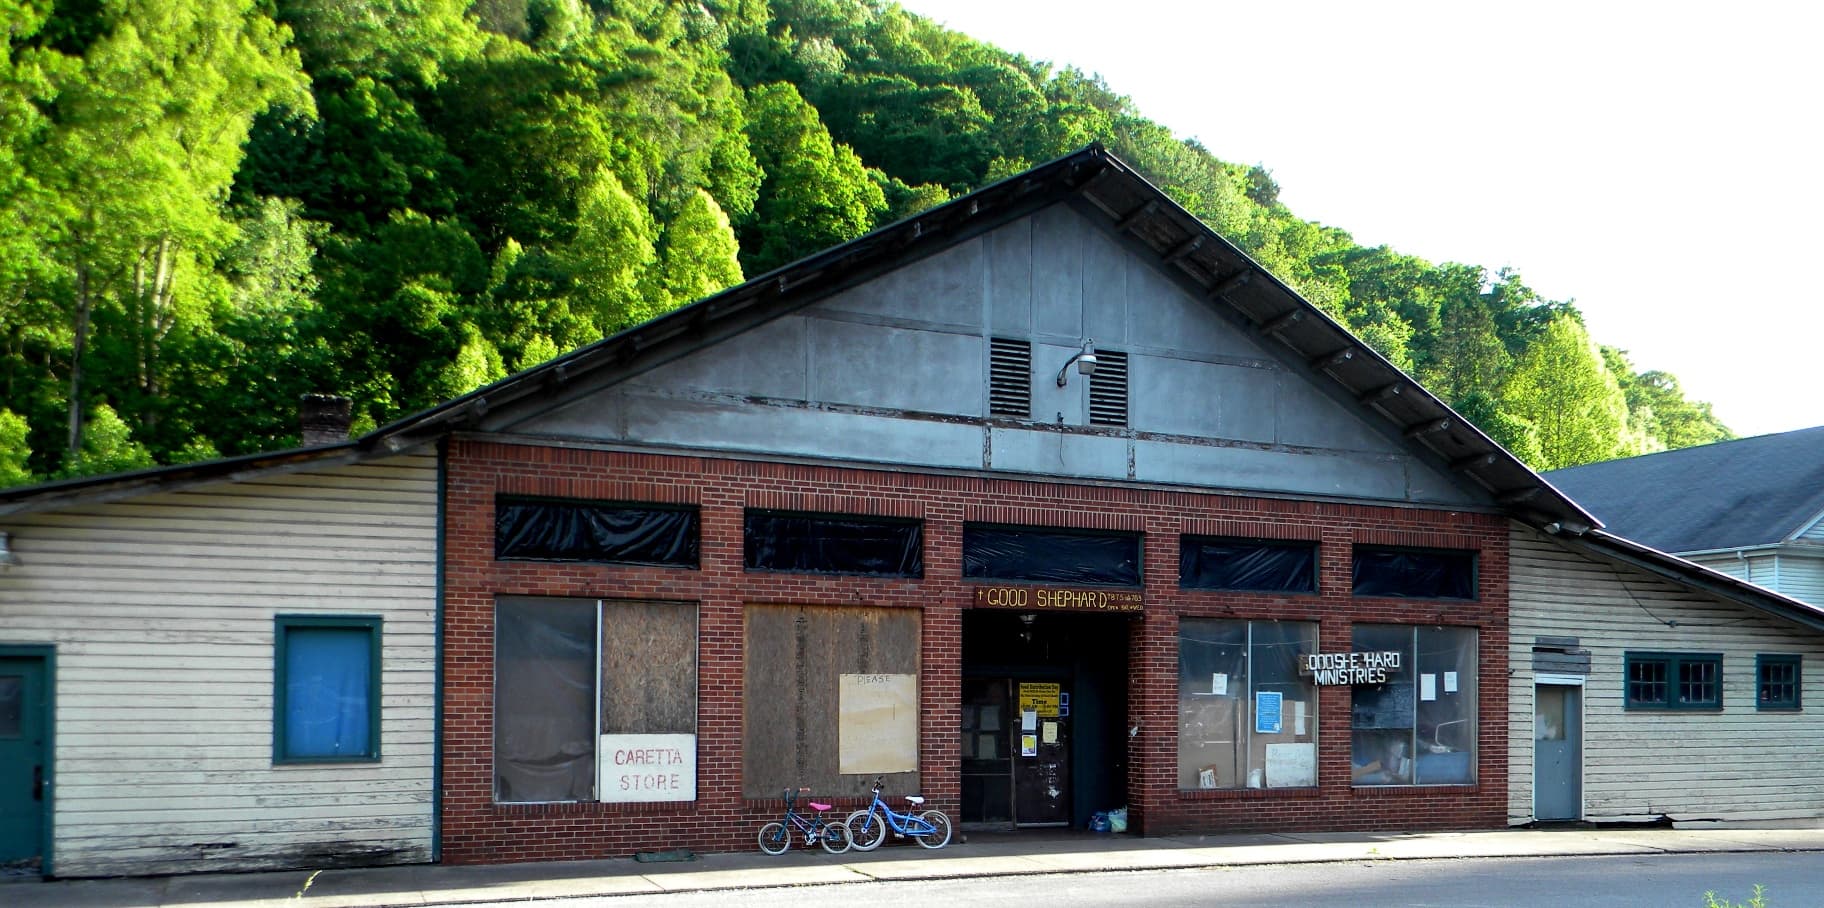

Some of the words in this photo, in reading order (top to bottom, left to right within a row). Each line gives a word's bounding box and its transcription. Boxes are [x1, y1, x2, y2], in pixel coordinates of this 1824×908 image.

[987, 588, 1028, 606] GOOD
[857, 675, 891, 686] PLEASE
[1314, 668, 1386, 686] MINISTRIES
[615, 749, 683, 766] CARETTA
[620, 774, 680, 791] STORE
